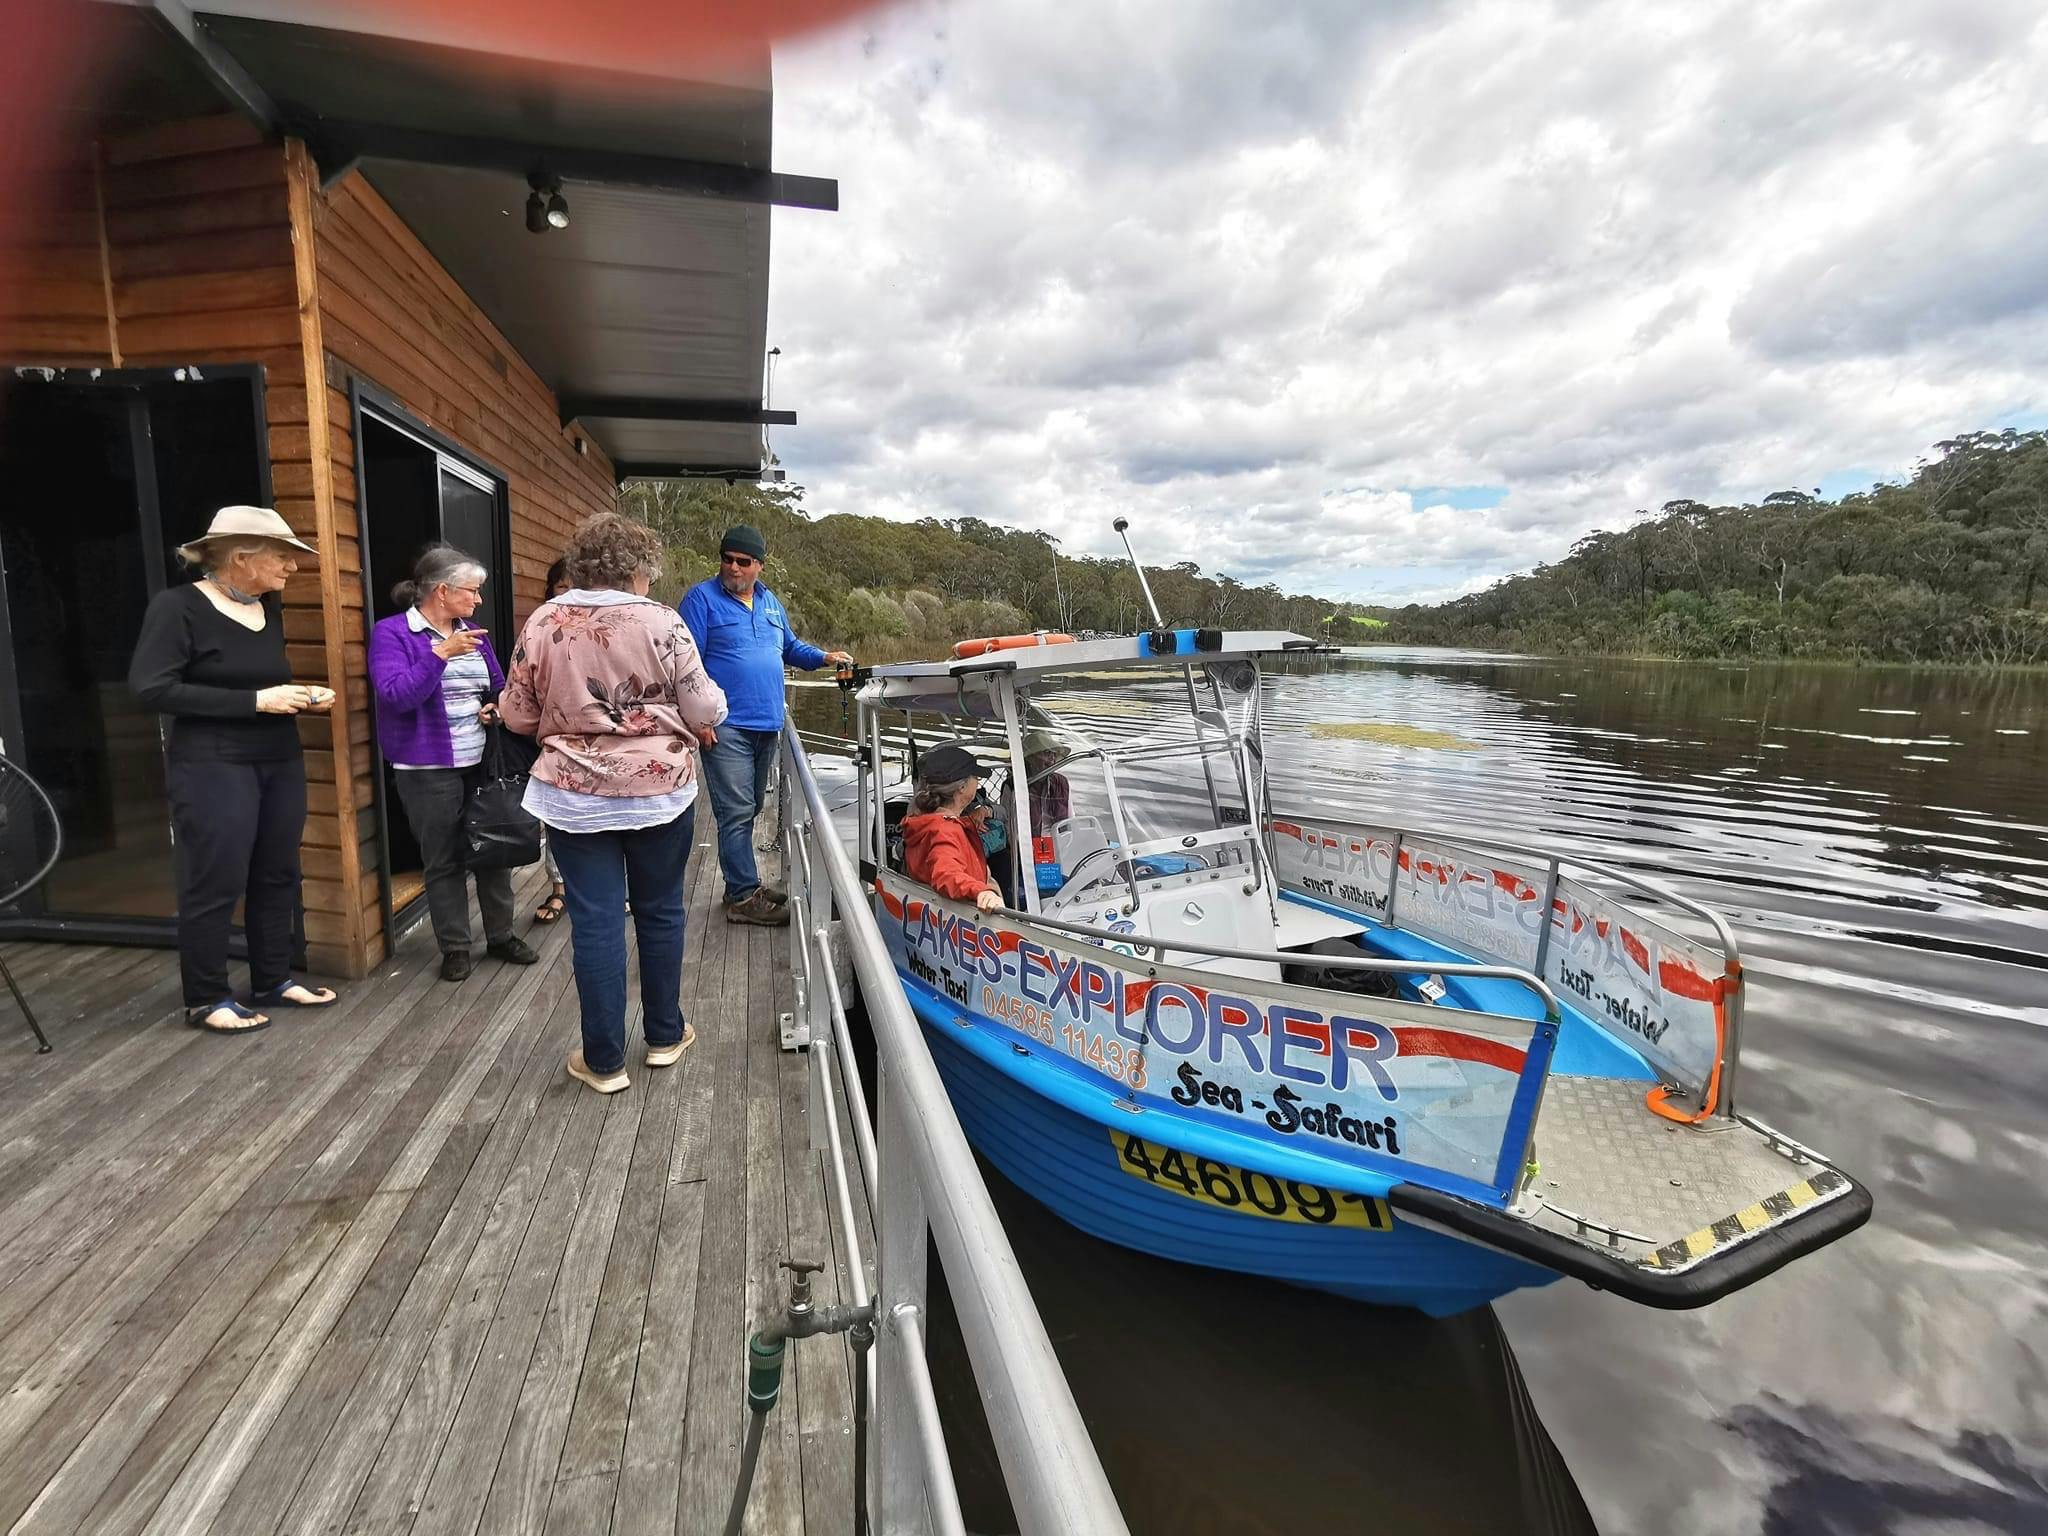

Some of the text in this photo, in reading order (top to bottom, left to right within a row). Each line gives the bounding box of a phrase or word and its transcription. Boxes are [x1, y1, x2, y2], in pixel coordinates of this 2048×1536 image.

[902, 894, 1399, 1102] LAKES-EXPLORER
[981, 984, 1147, 1090] 04585 11438
[1122, 1134, 1384, 1228] 446091
